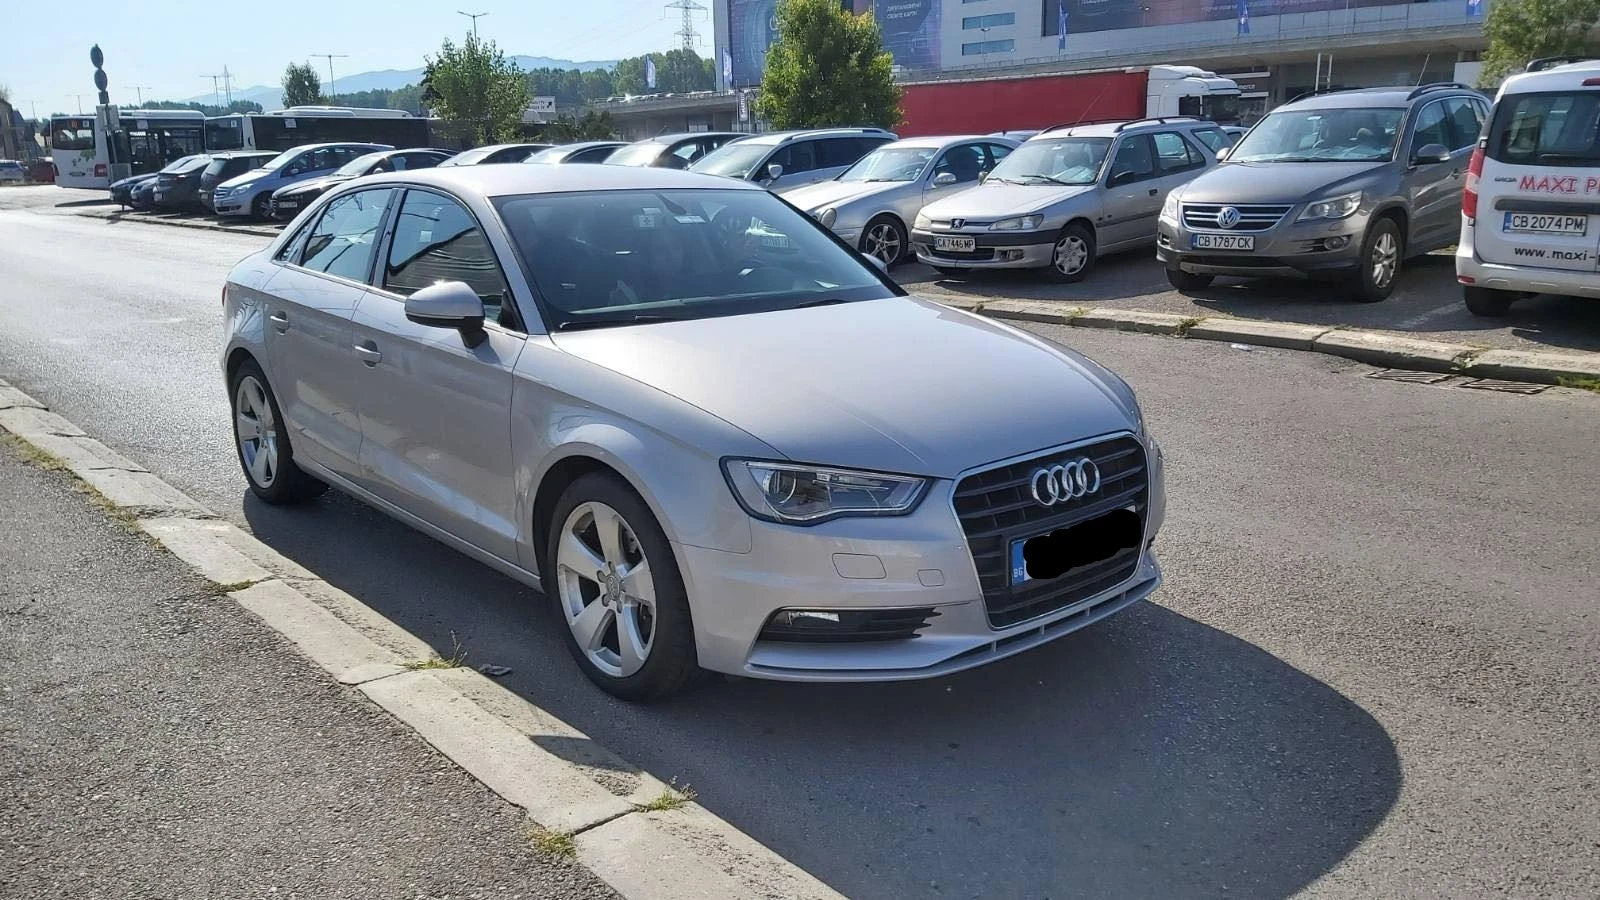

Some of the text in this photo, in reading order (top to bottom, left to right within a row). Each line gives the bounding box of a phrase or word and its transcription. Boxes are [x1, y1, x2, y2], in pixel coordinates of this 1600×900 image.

[1519, 175, 1600, 194] MAXI P
[1512, 215, 1584, 230] CB 2074 PM
[1213, 237, 1236, 249] 1787
[1514, 247, 1600, 265] www.maxi-
[1013, 566, 1024, 578] BG
